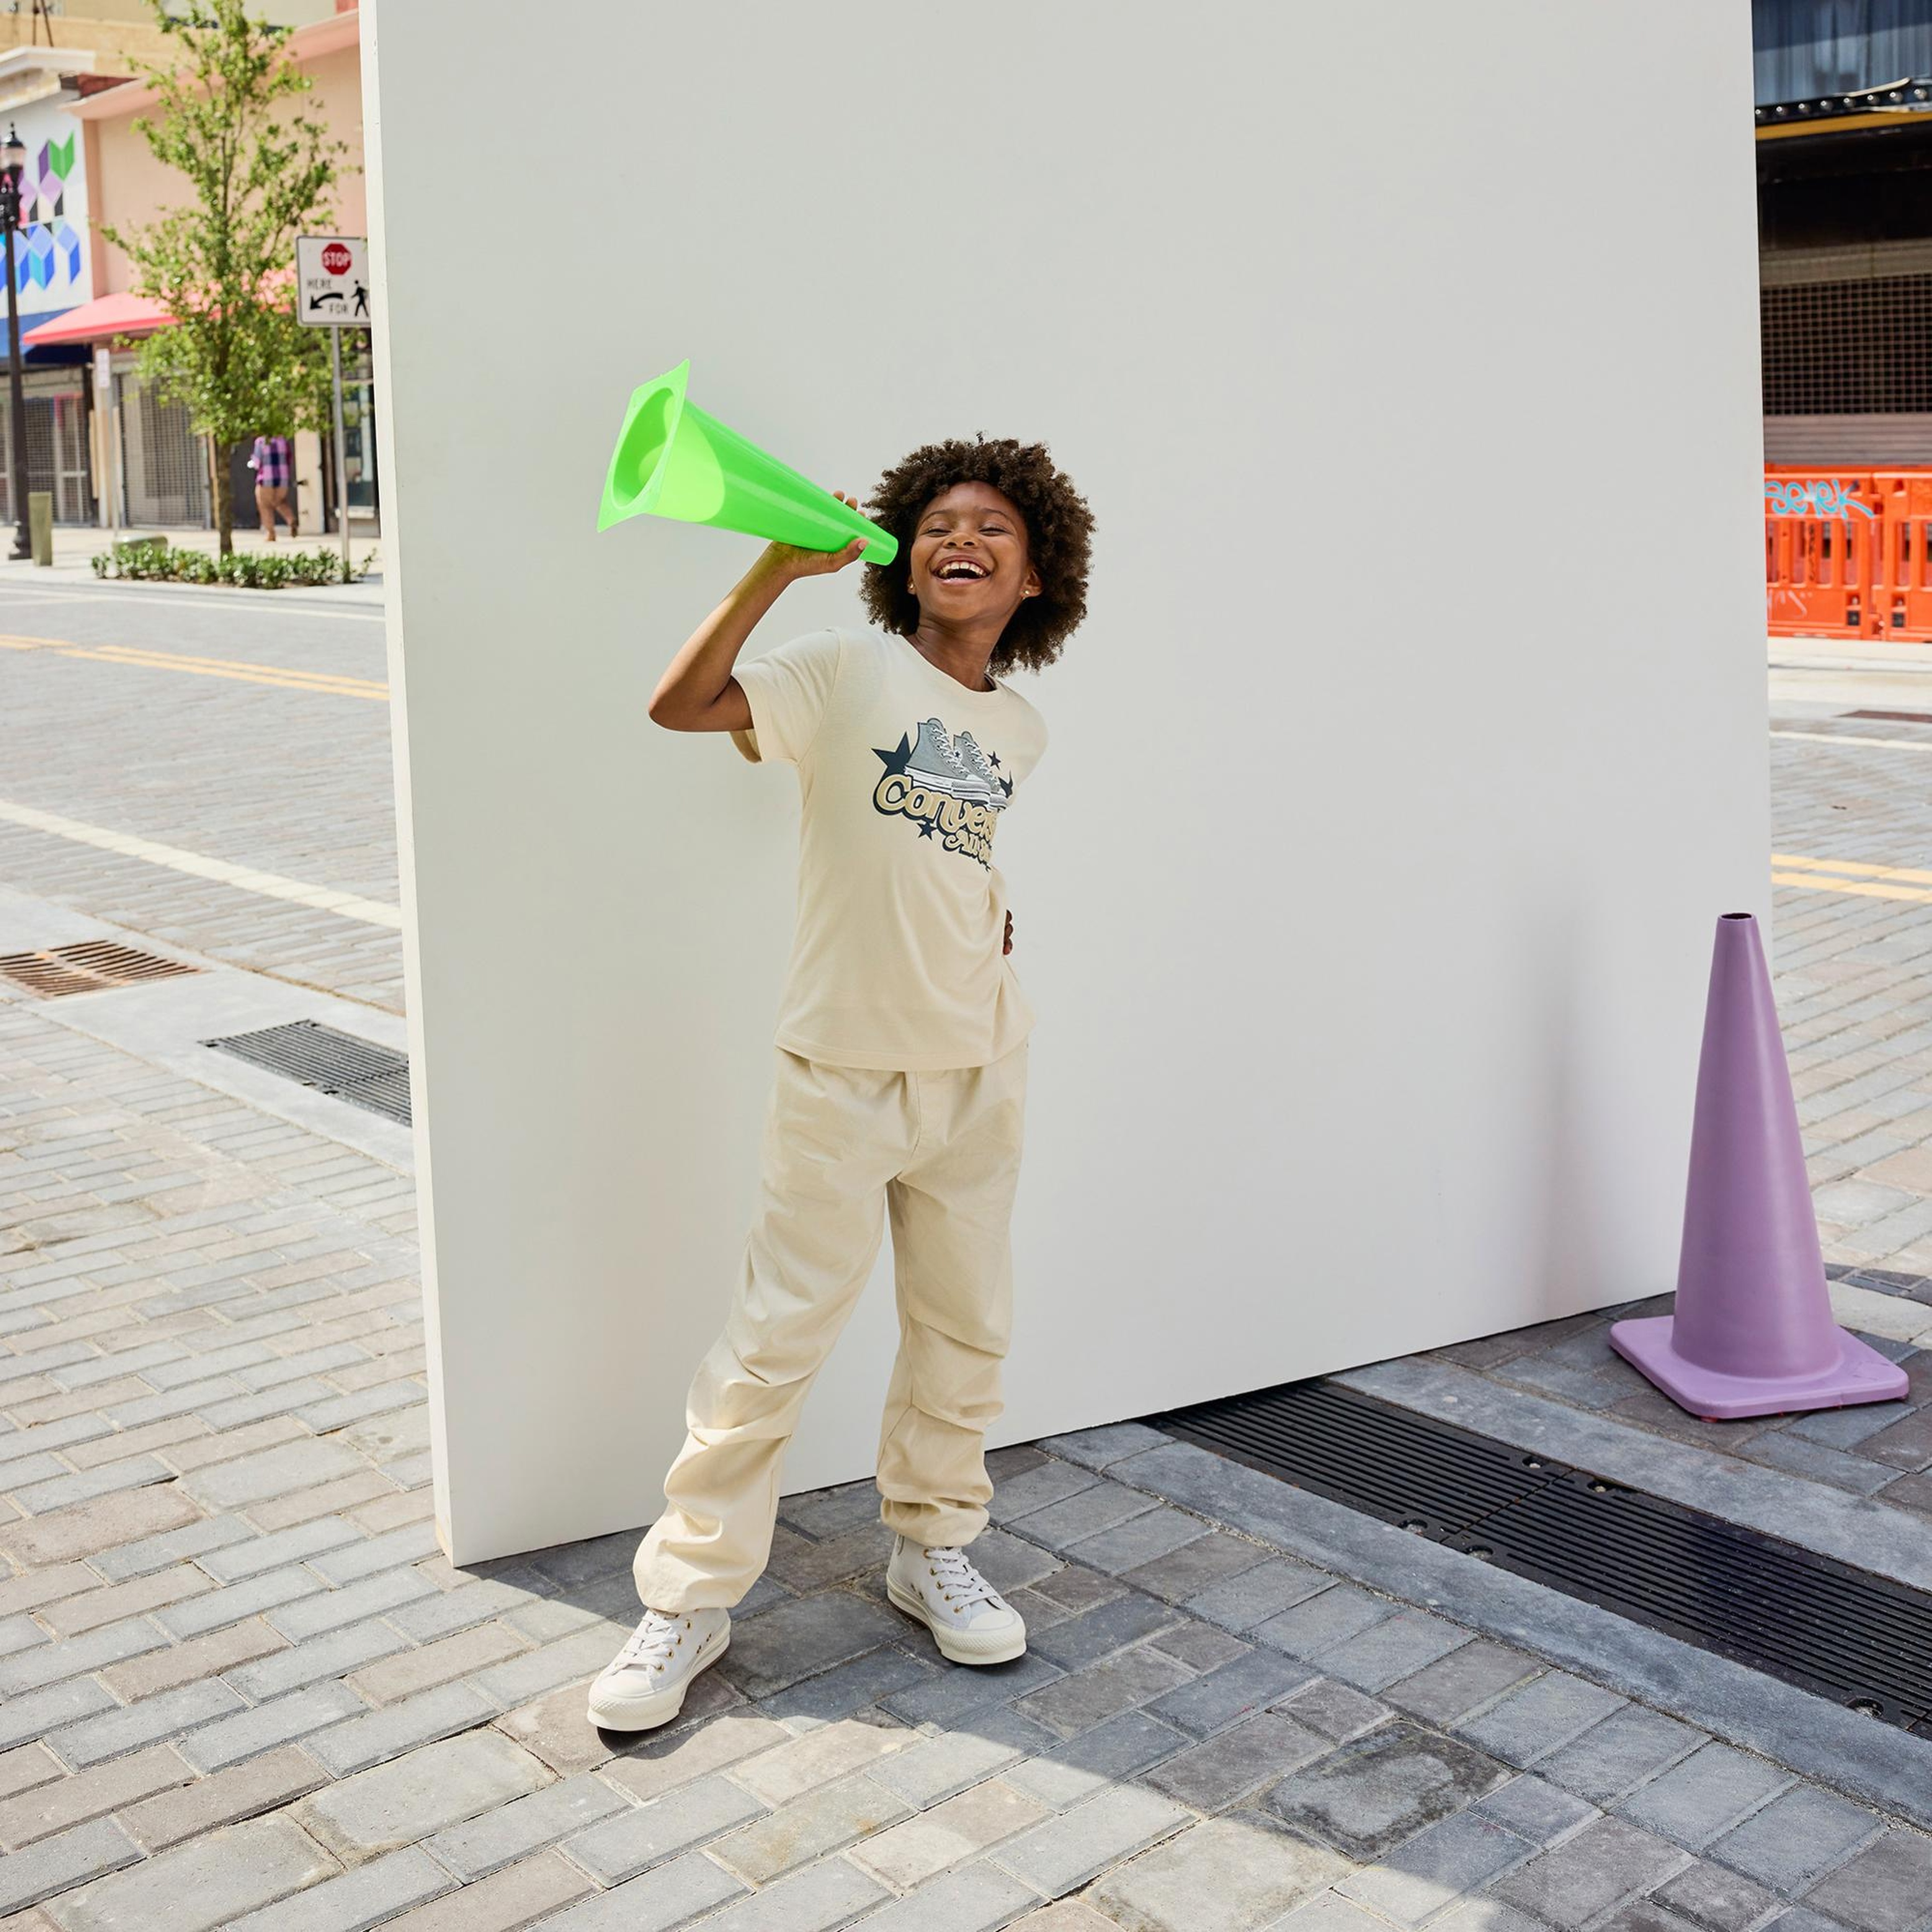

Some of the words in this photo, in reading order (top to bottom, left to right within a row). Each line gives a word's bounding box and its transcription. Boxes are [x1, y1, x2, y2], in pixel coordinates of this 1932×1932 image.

[323, 252, 351, 267] STOP
[307, 279, 331, 289] HERE
[329, 304, 348, 313] FOR
